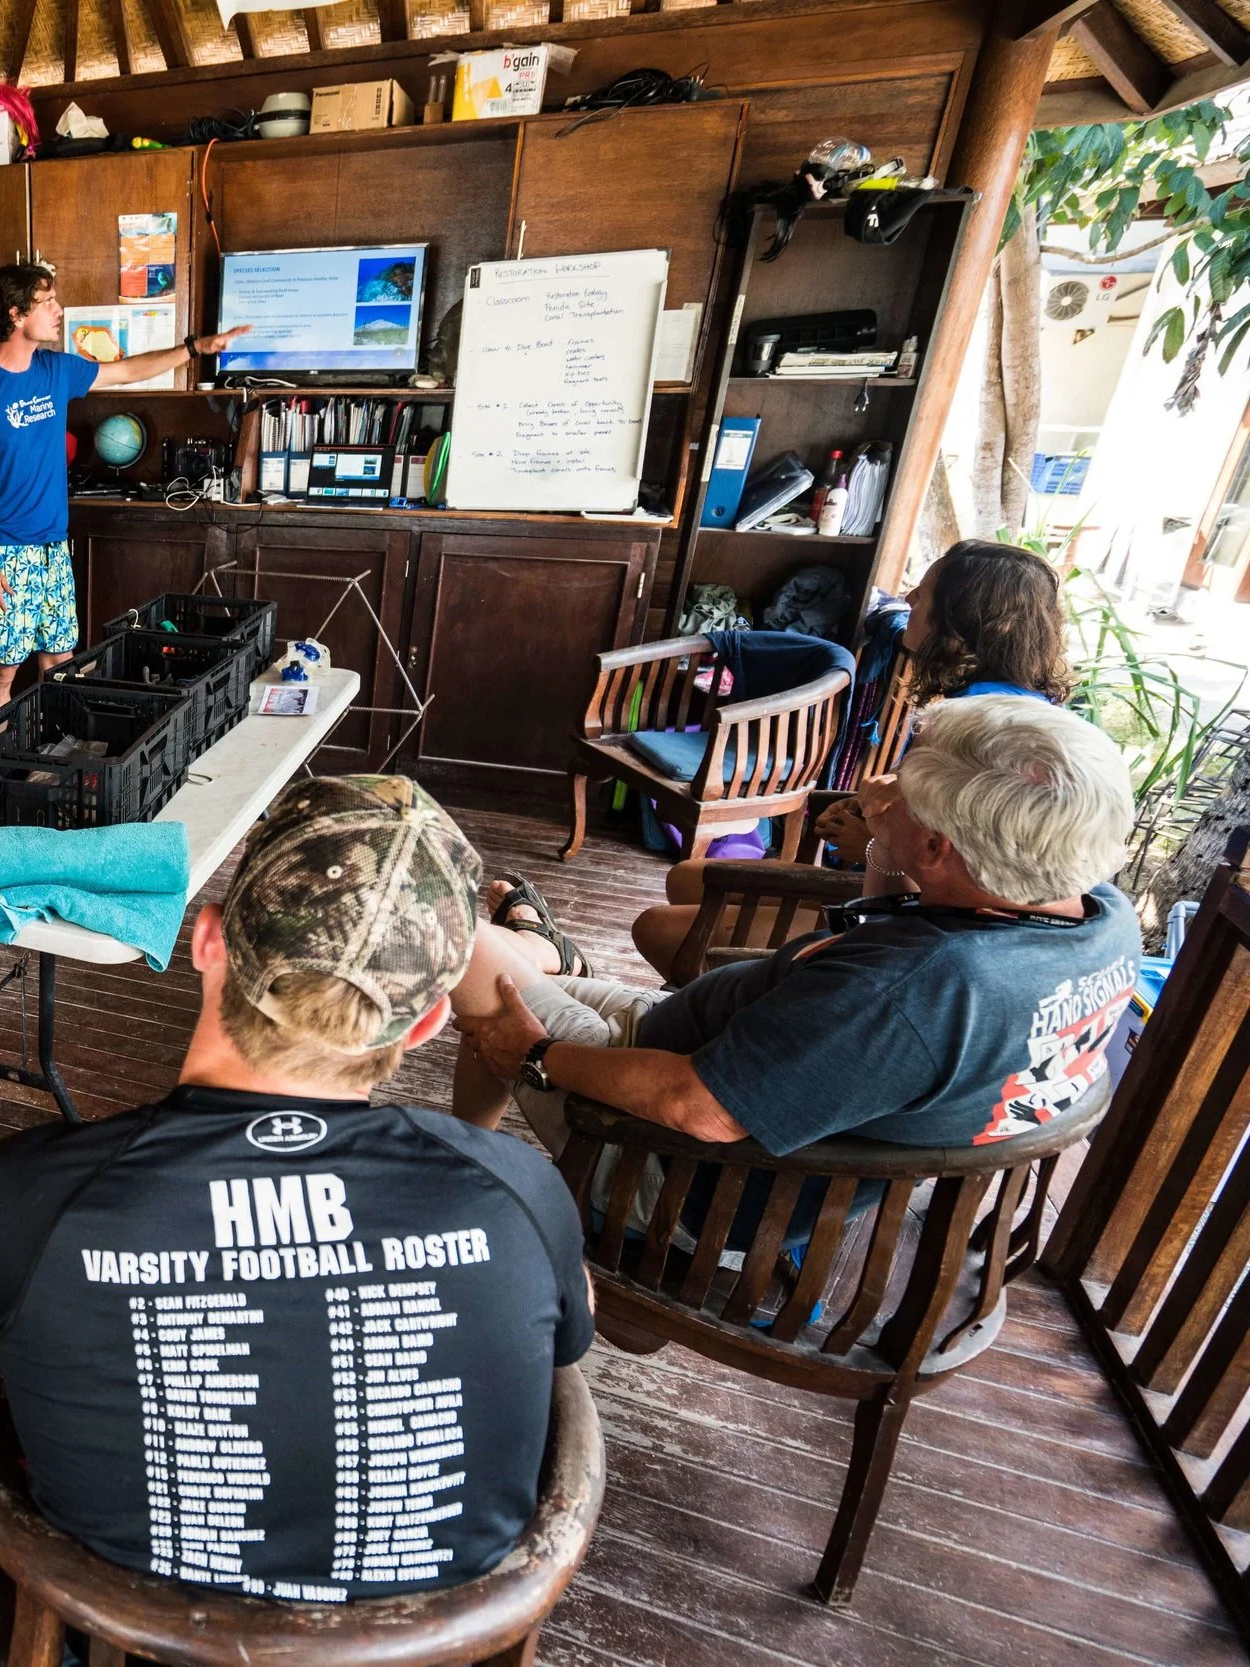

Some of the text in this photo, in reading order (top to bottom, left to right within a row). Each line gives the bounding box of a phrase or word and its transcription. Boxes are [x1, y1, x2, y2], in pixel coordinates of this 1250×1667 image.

[1096, 293, 1110, 302] LG
[29, 400, 54, 414] Marine
[24, 408, 57, 424] Research
[1030, 994, 1083, 1039] HAND
[1082, 960, 1136, 1017] SIGNALS
[209, 1172, 354, 1248] HMB
[81, 1227, 491, 1285] VARSITY FOOTBALL ROSTER
[358, 1285, 386, 1299] NICK
[388, 1281, 436, 1297] DEMPSEY
[129, 1293, 246, 1310] #2 SEAN FITZGERALD
[131, 1313, 147, 1325] #3
[362, 1319, 392, 1333] JACK
[133, 1328, 149, 1341] #4
[144, 1433, 164, 1448] #11
